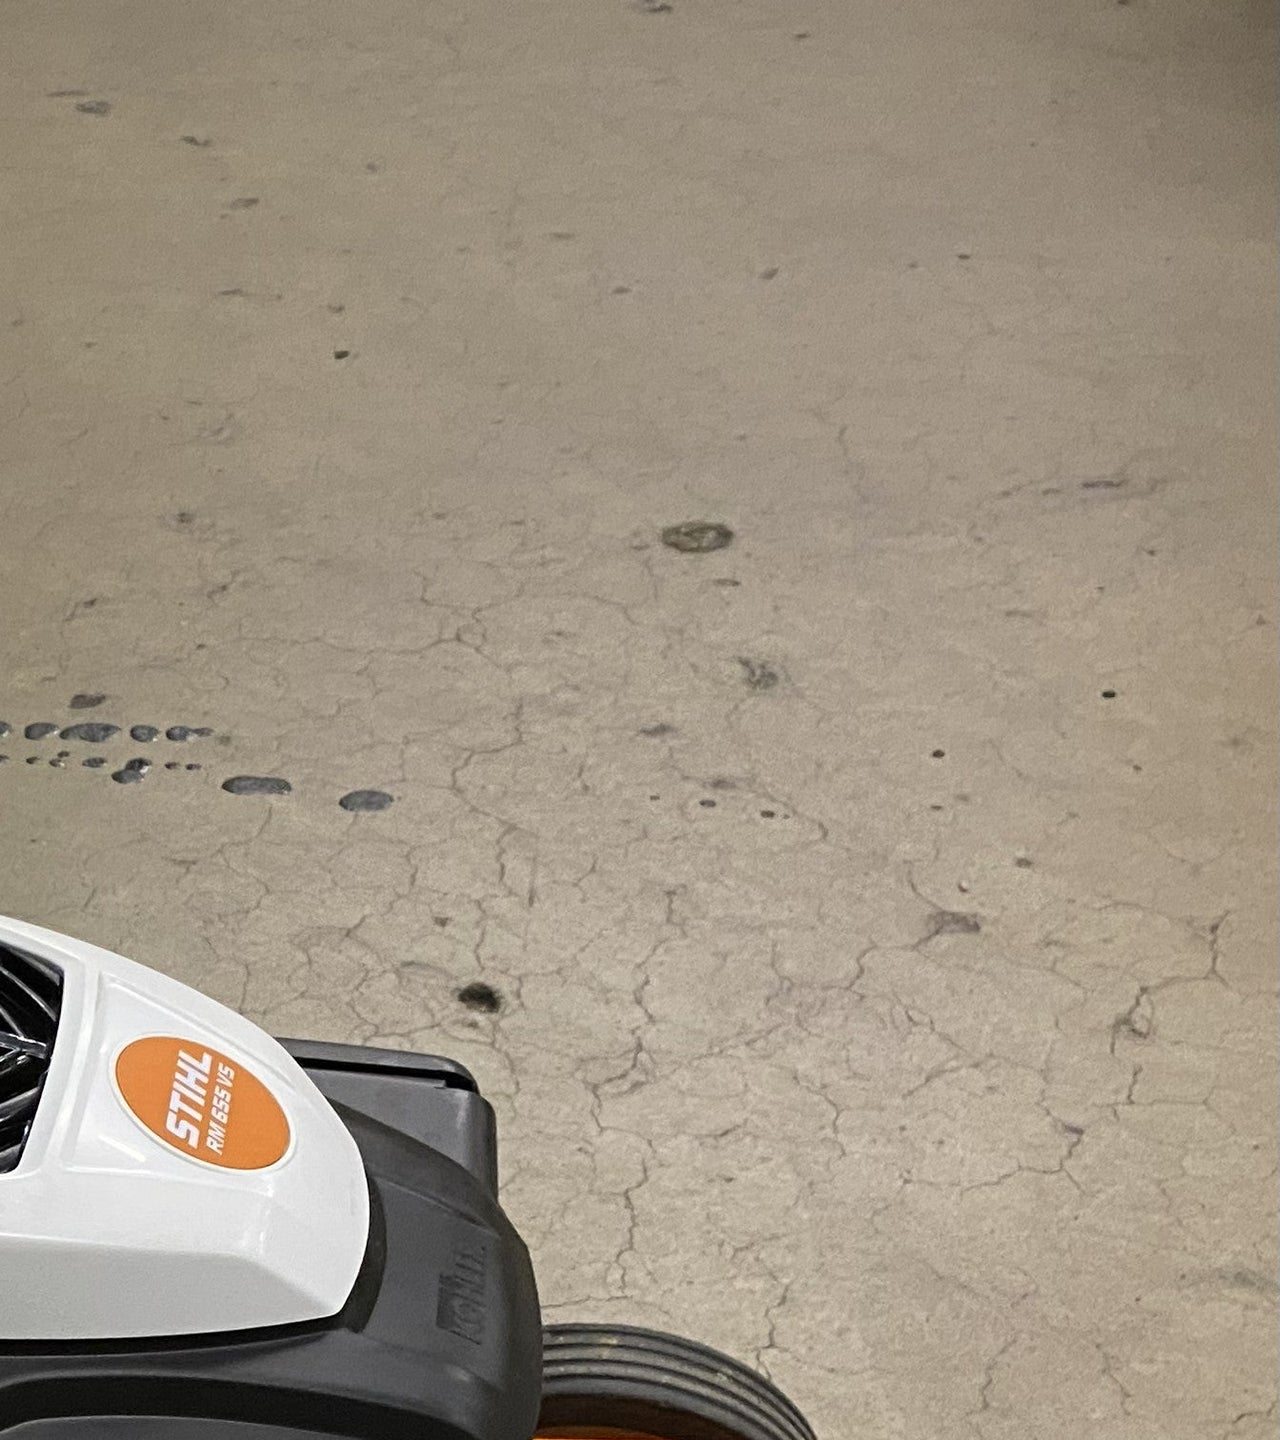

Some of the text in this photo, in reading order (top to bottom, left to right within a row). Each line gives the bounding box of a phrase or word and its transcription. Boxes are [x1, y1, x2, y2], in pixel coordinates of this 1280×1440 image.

[166, 1049, 212, 1149] STIHL
[206, 1062, 235, 1155] RM 655 VS
